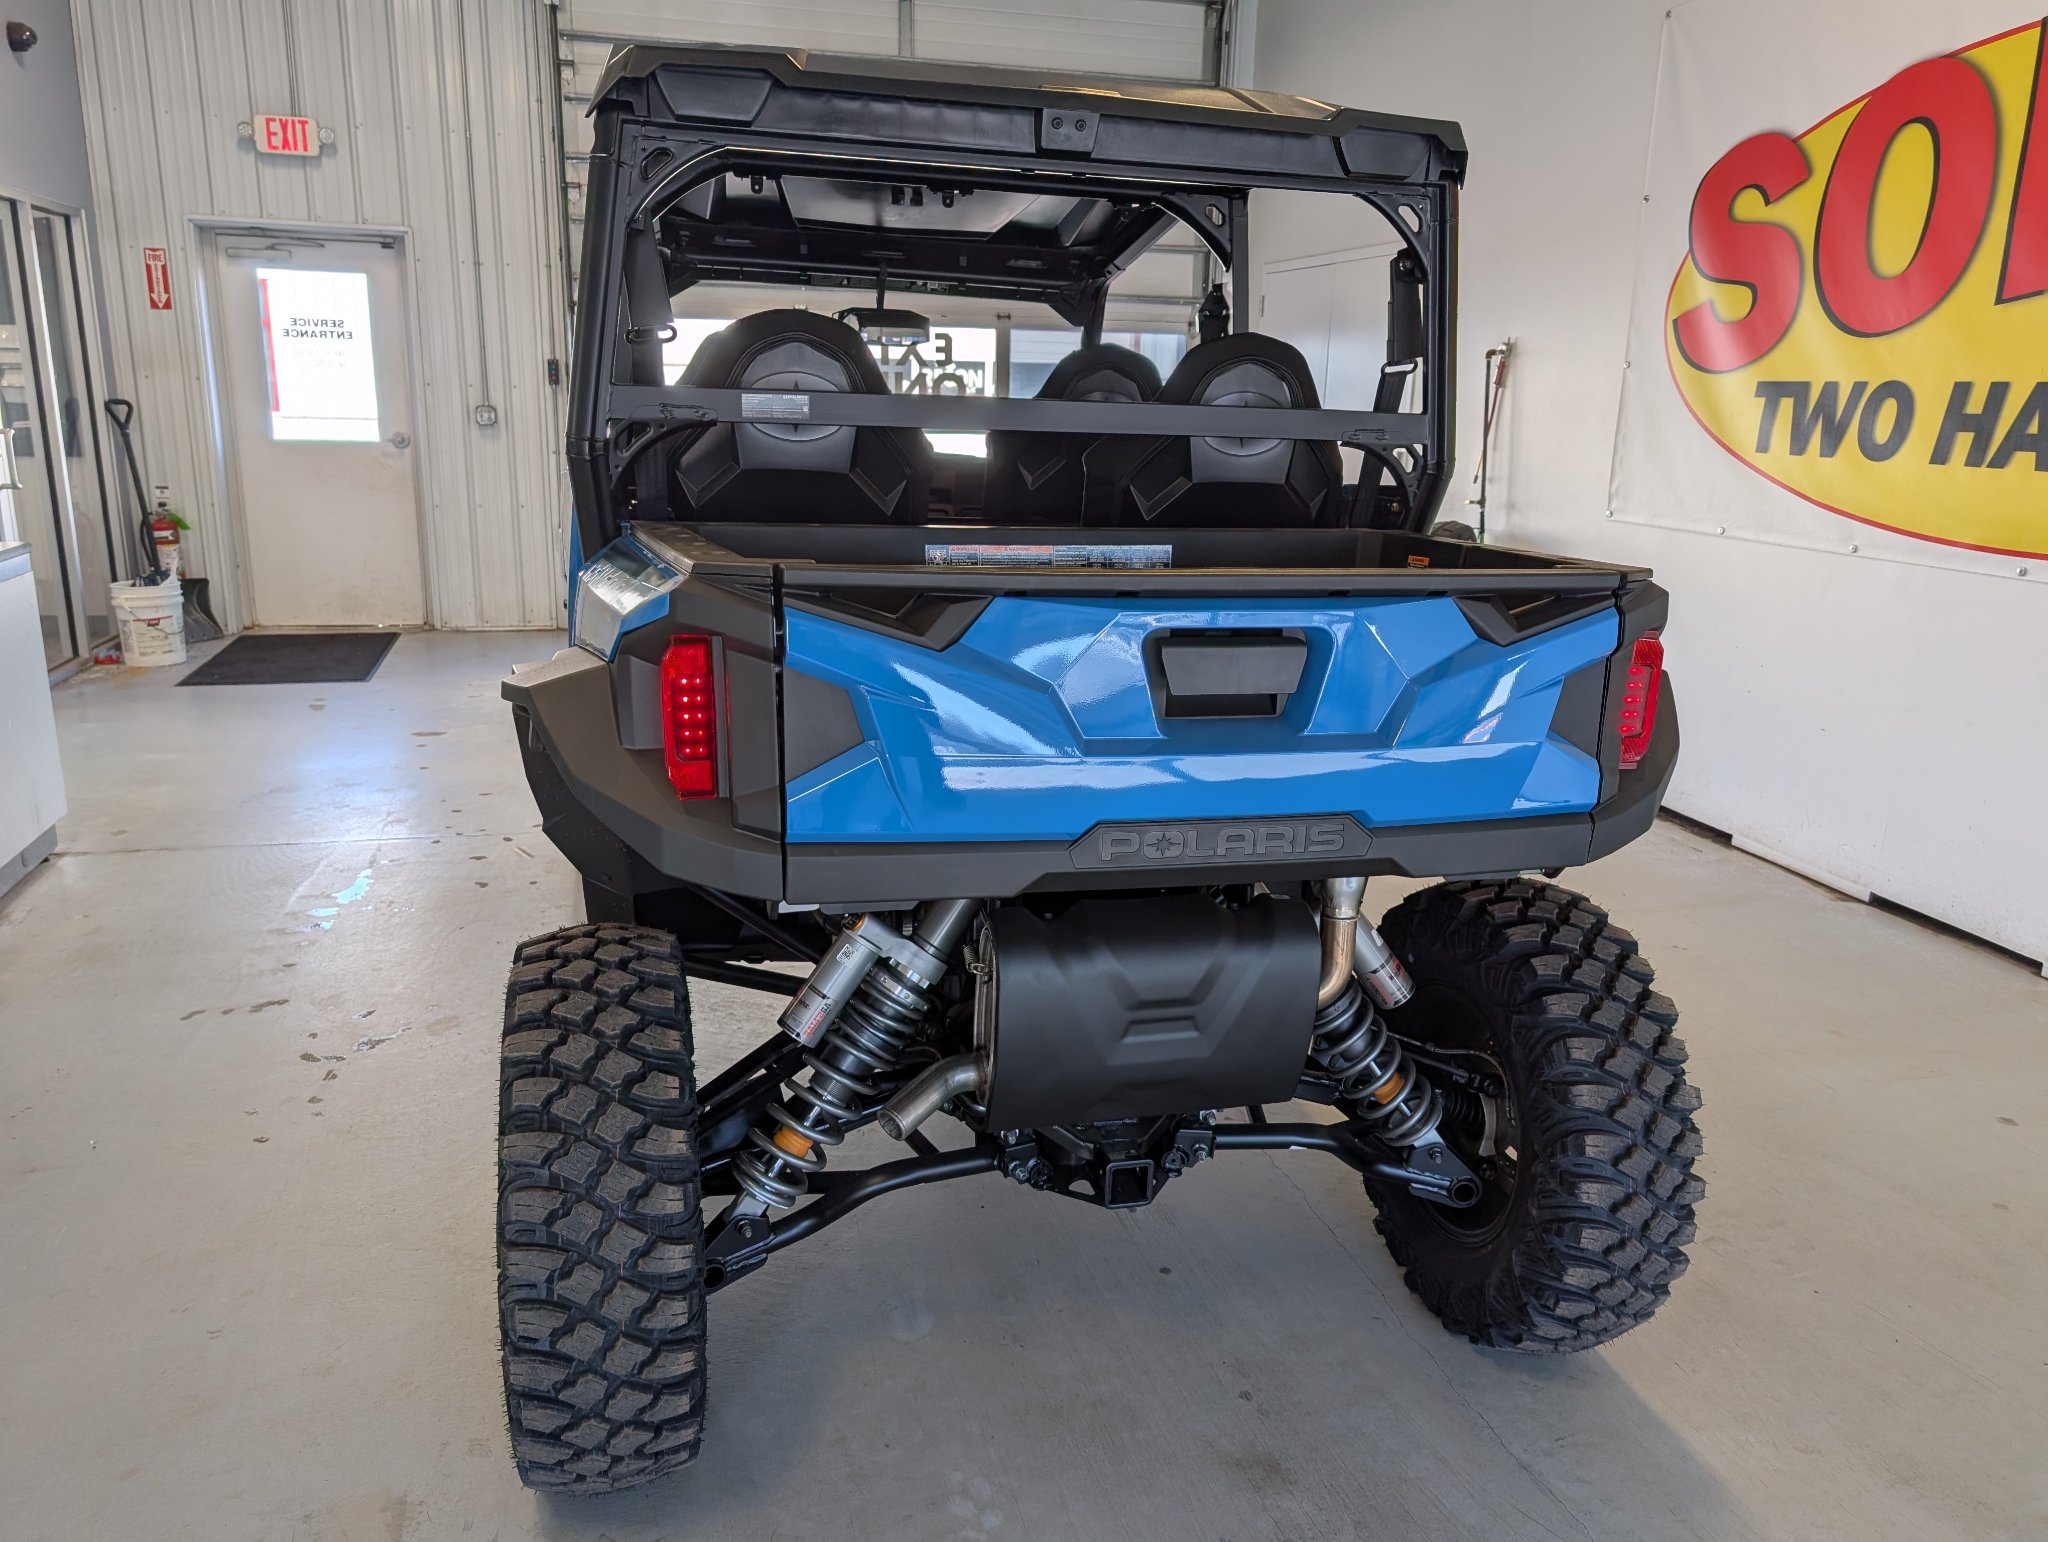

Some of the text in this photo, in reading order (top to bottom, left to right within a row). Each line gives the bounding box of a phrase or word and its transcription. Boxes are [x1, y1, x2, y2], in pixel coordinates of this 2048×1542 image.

[265, 117, 309, 152] EXIT
[1754, 379, 1916, 462] TWO
[1101, 823, 1345, 862] POLARIS
